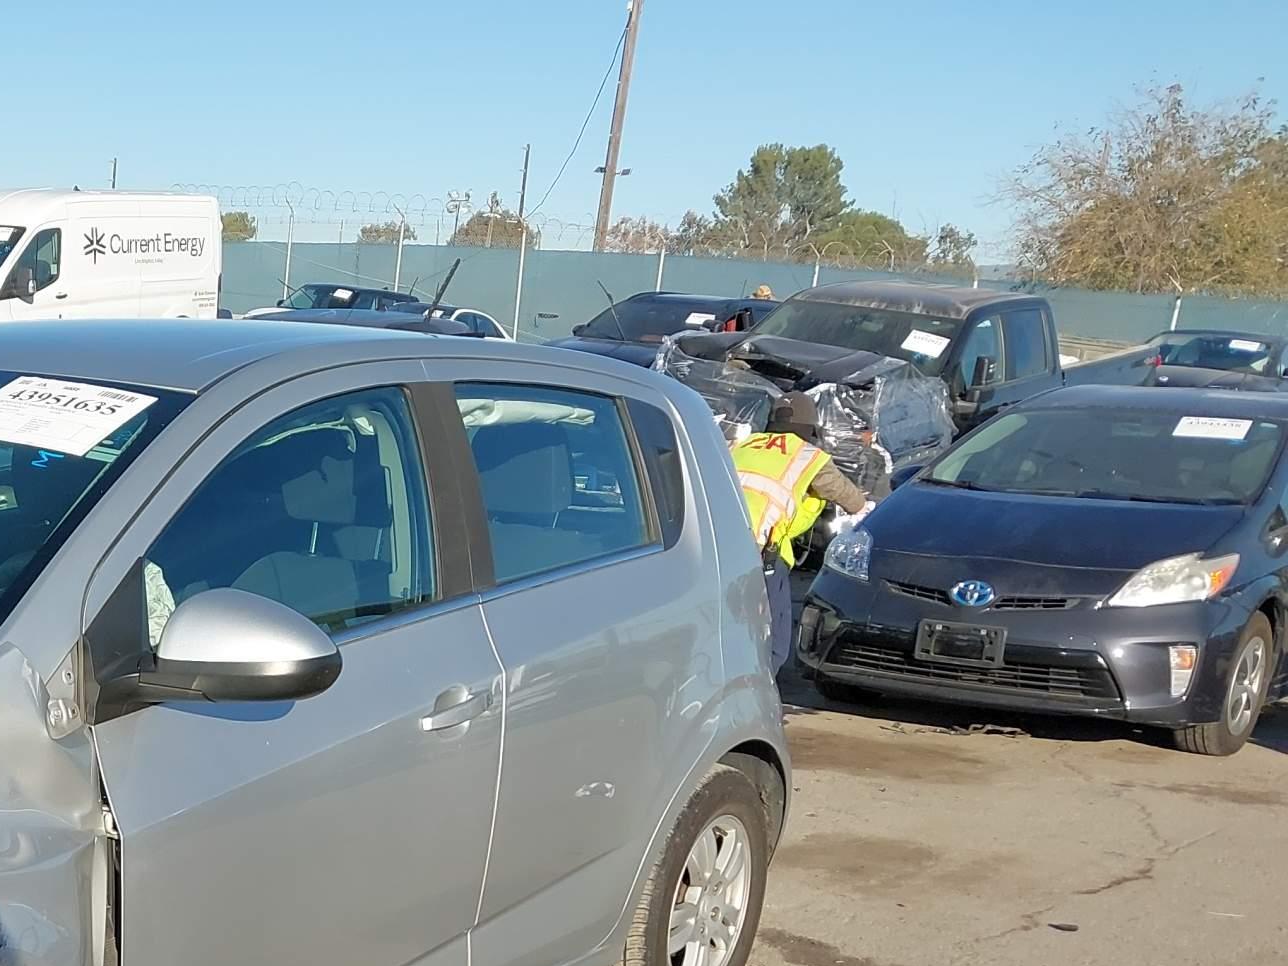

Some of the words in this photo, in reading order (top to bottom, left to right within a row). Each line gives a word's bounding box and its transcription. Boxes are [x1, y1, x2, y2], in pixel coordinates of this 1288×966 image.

[110, 233, 162, 254] Current
[164, 232, 206, 257] Energy
[8, 389, 123, 415] 43951635
